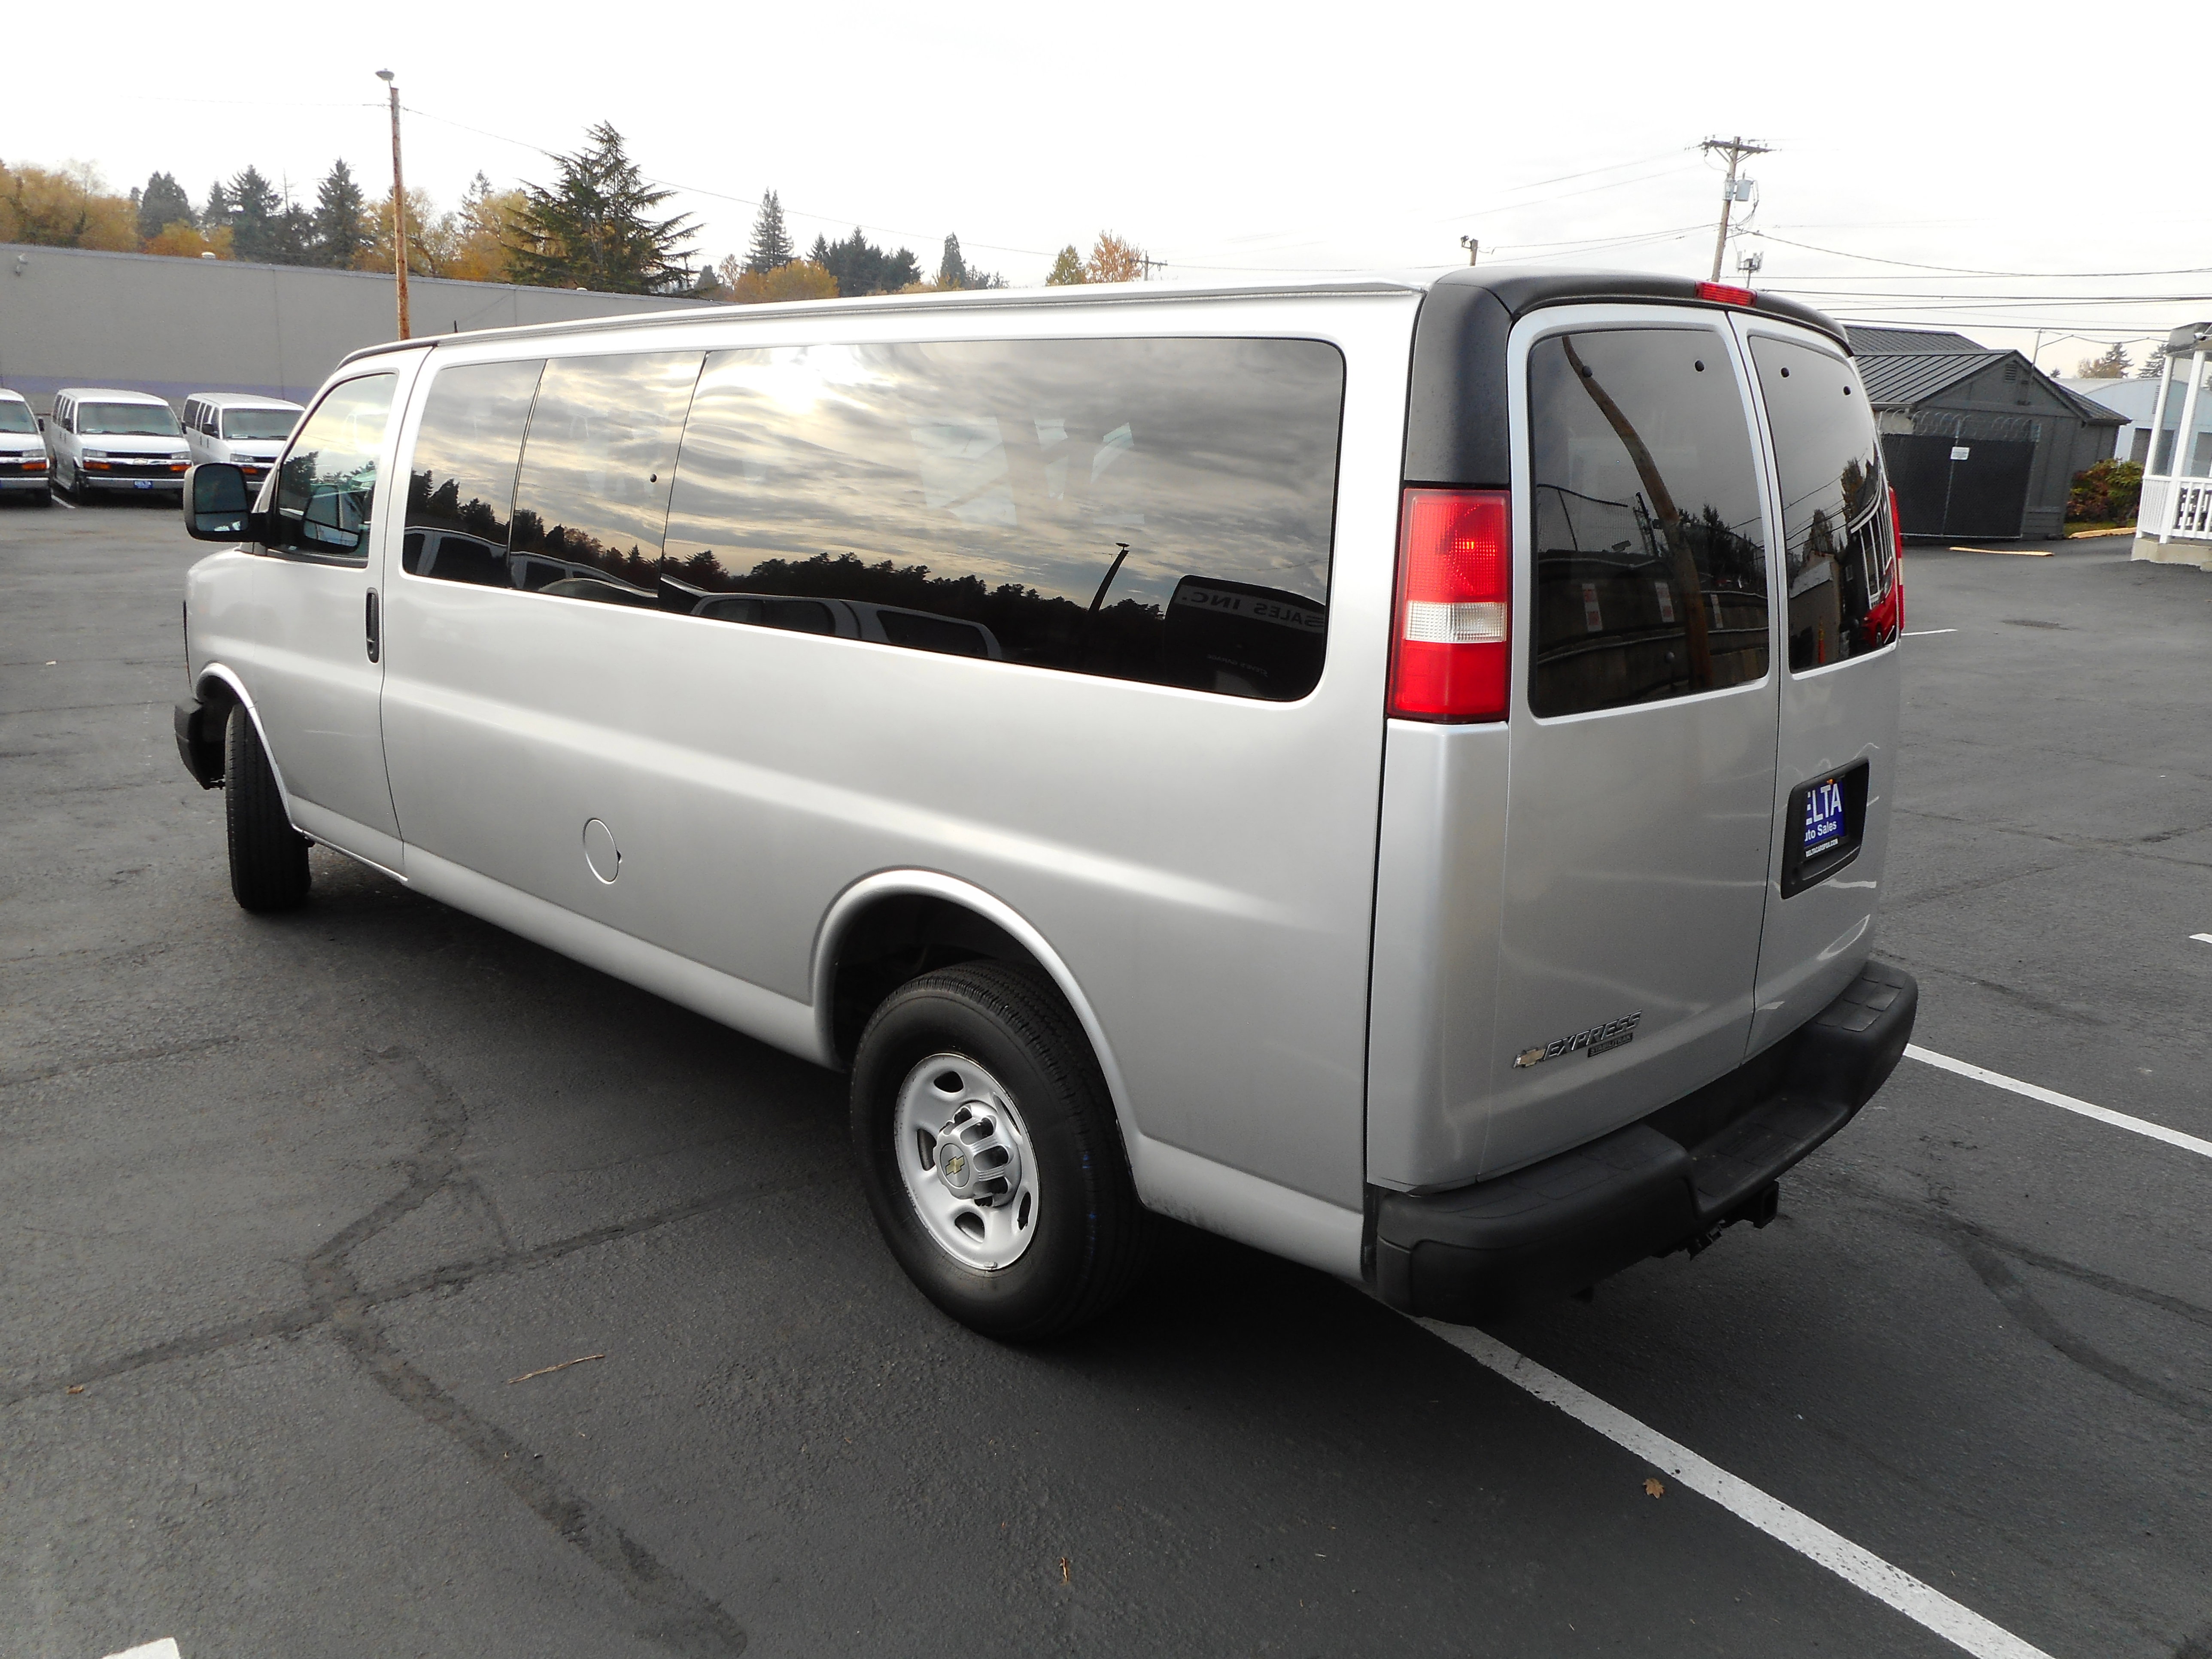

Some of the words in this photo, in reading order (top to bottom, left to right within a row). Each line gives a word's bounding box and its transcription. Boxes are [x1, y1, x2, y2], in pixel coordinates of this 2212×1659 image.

[1806, 783, 1842, 825] LTA
[1805, 829, 1816, 842] uto
[1817, 821, 1837, 836] Sales
[1544, 1010, 1641, 1061] EXPRESS
